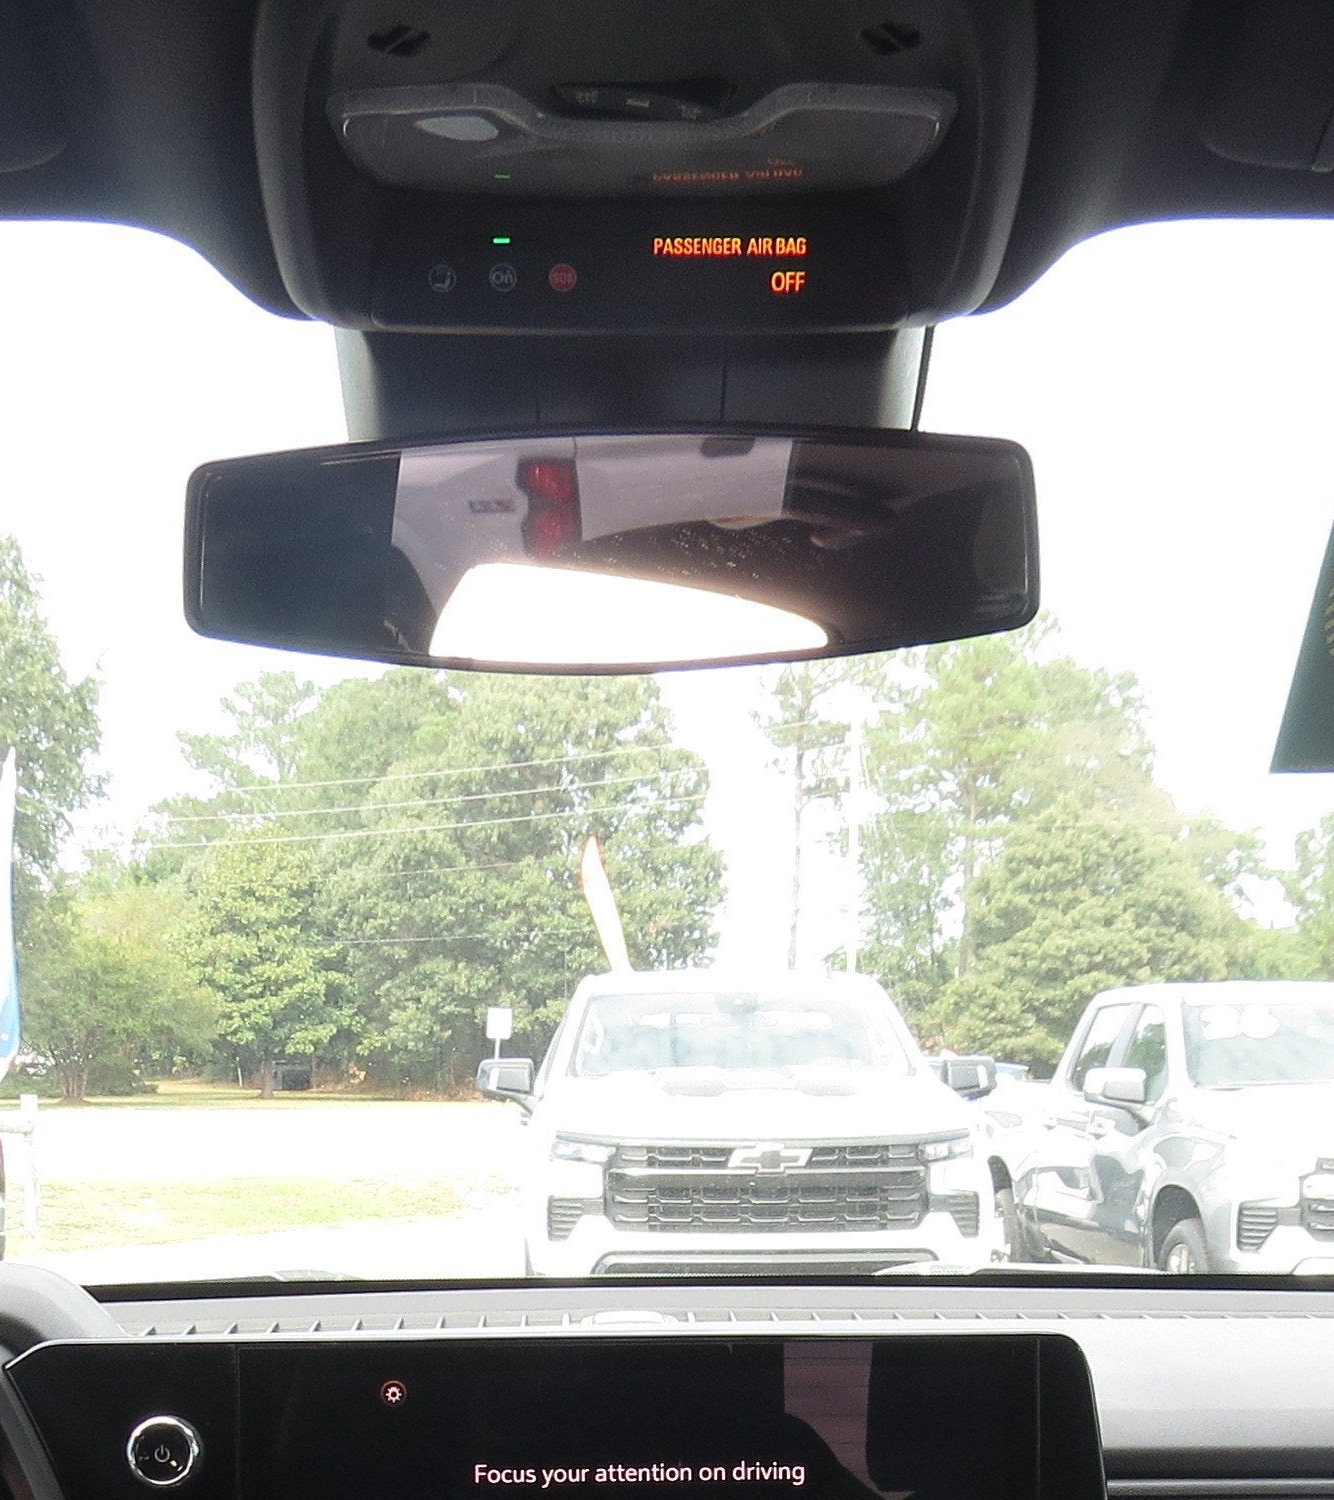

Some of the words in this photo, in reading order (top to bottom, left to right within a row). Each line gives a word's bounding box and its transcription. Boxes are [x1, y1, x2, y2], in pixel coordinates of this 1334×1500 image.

[653, 237, 742, 255] PASSENGER
[746, 237, 772, 255] AIR
[775, 237, 807, 255] BAG
[770, 271, 806, 292] OFF
[474, 1464, 537, 1484] Focus
[541, 1467, 590, 1488] your
[594, 1462, 693, 1483] attention
[698, 1466, 726, 1482] on
[732, 1460, 805, 1486] driving
